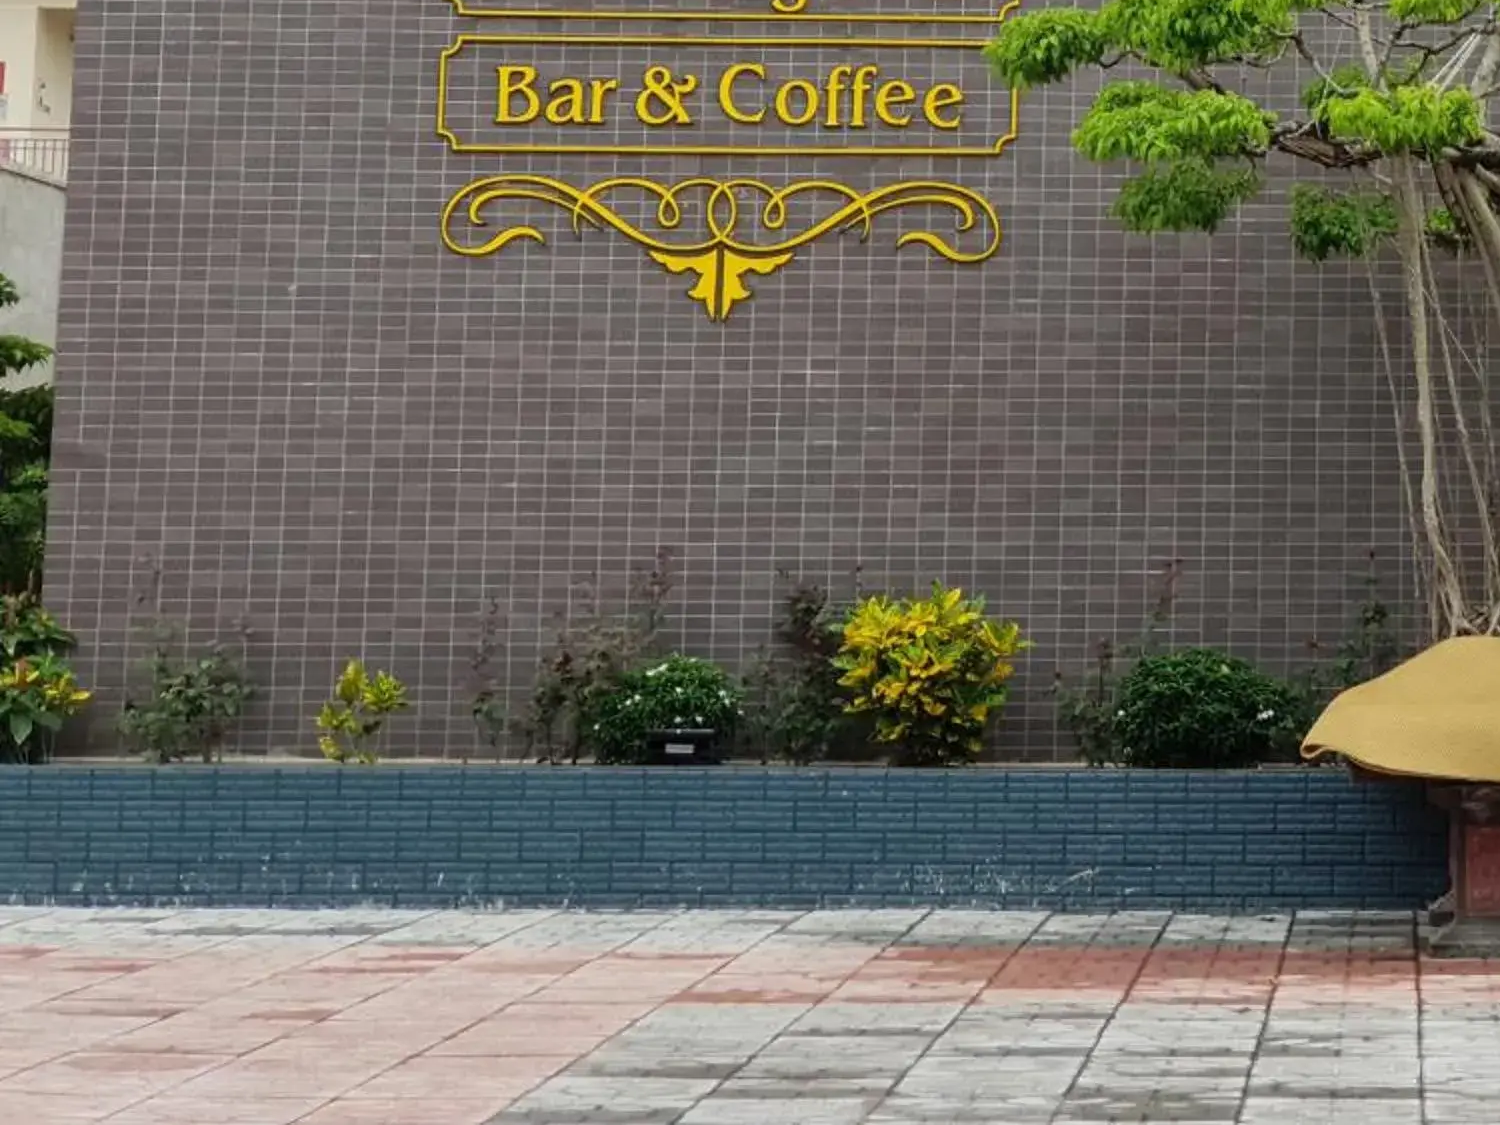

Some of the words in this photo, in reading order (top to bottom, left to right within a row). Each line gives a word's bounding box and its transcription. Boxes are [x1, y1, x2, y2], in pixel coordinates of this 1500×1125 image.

[495, 64, 618, 125] Bar
[634, 64, 698, 126] &
[718, 62, 964, 129] Coffee
